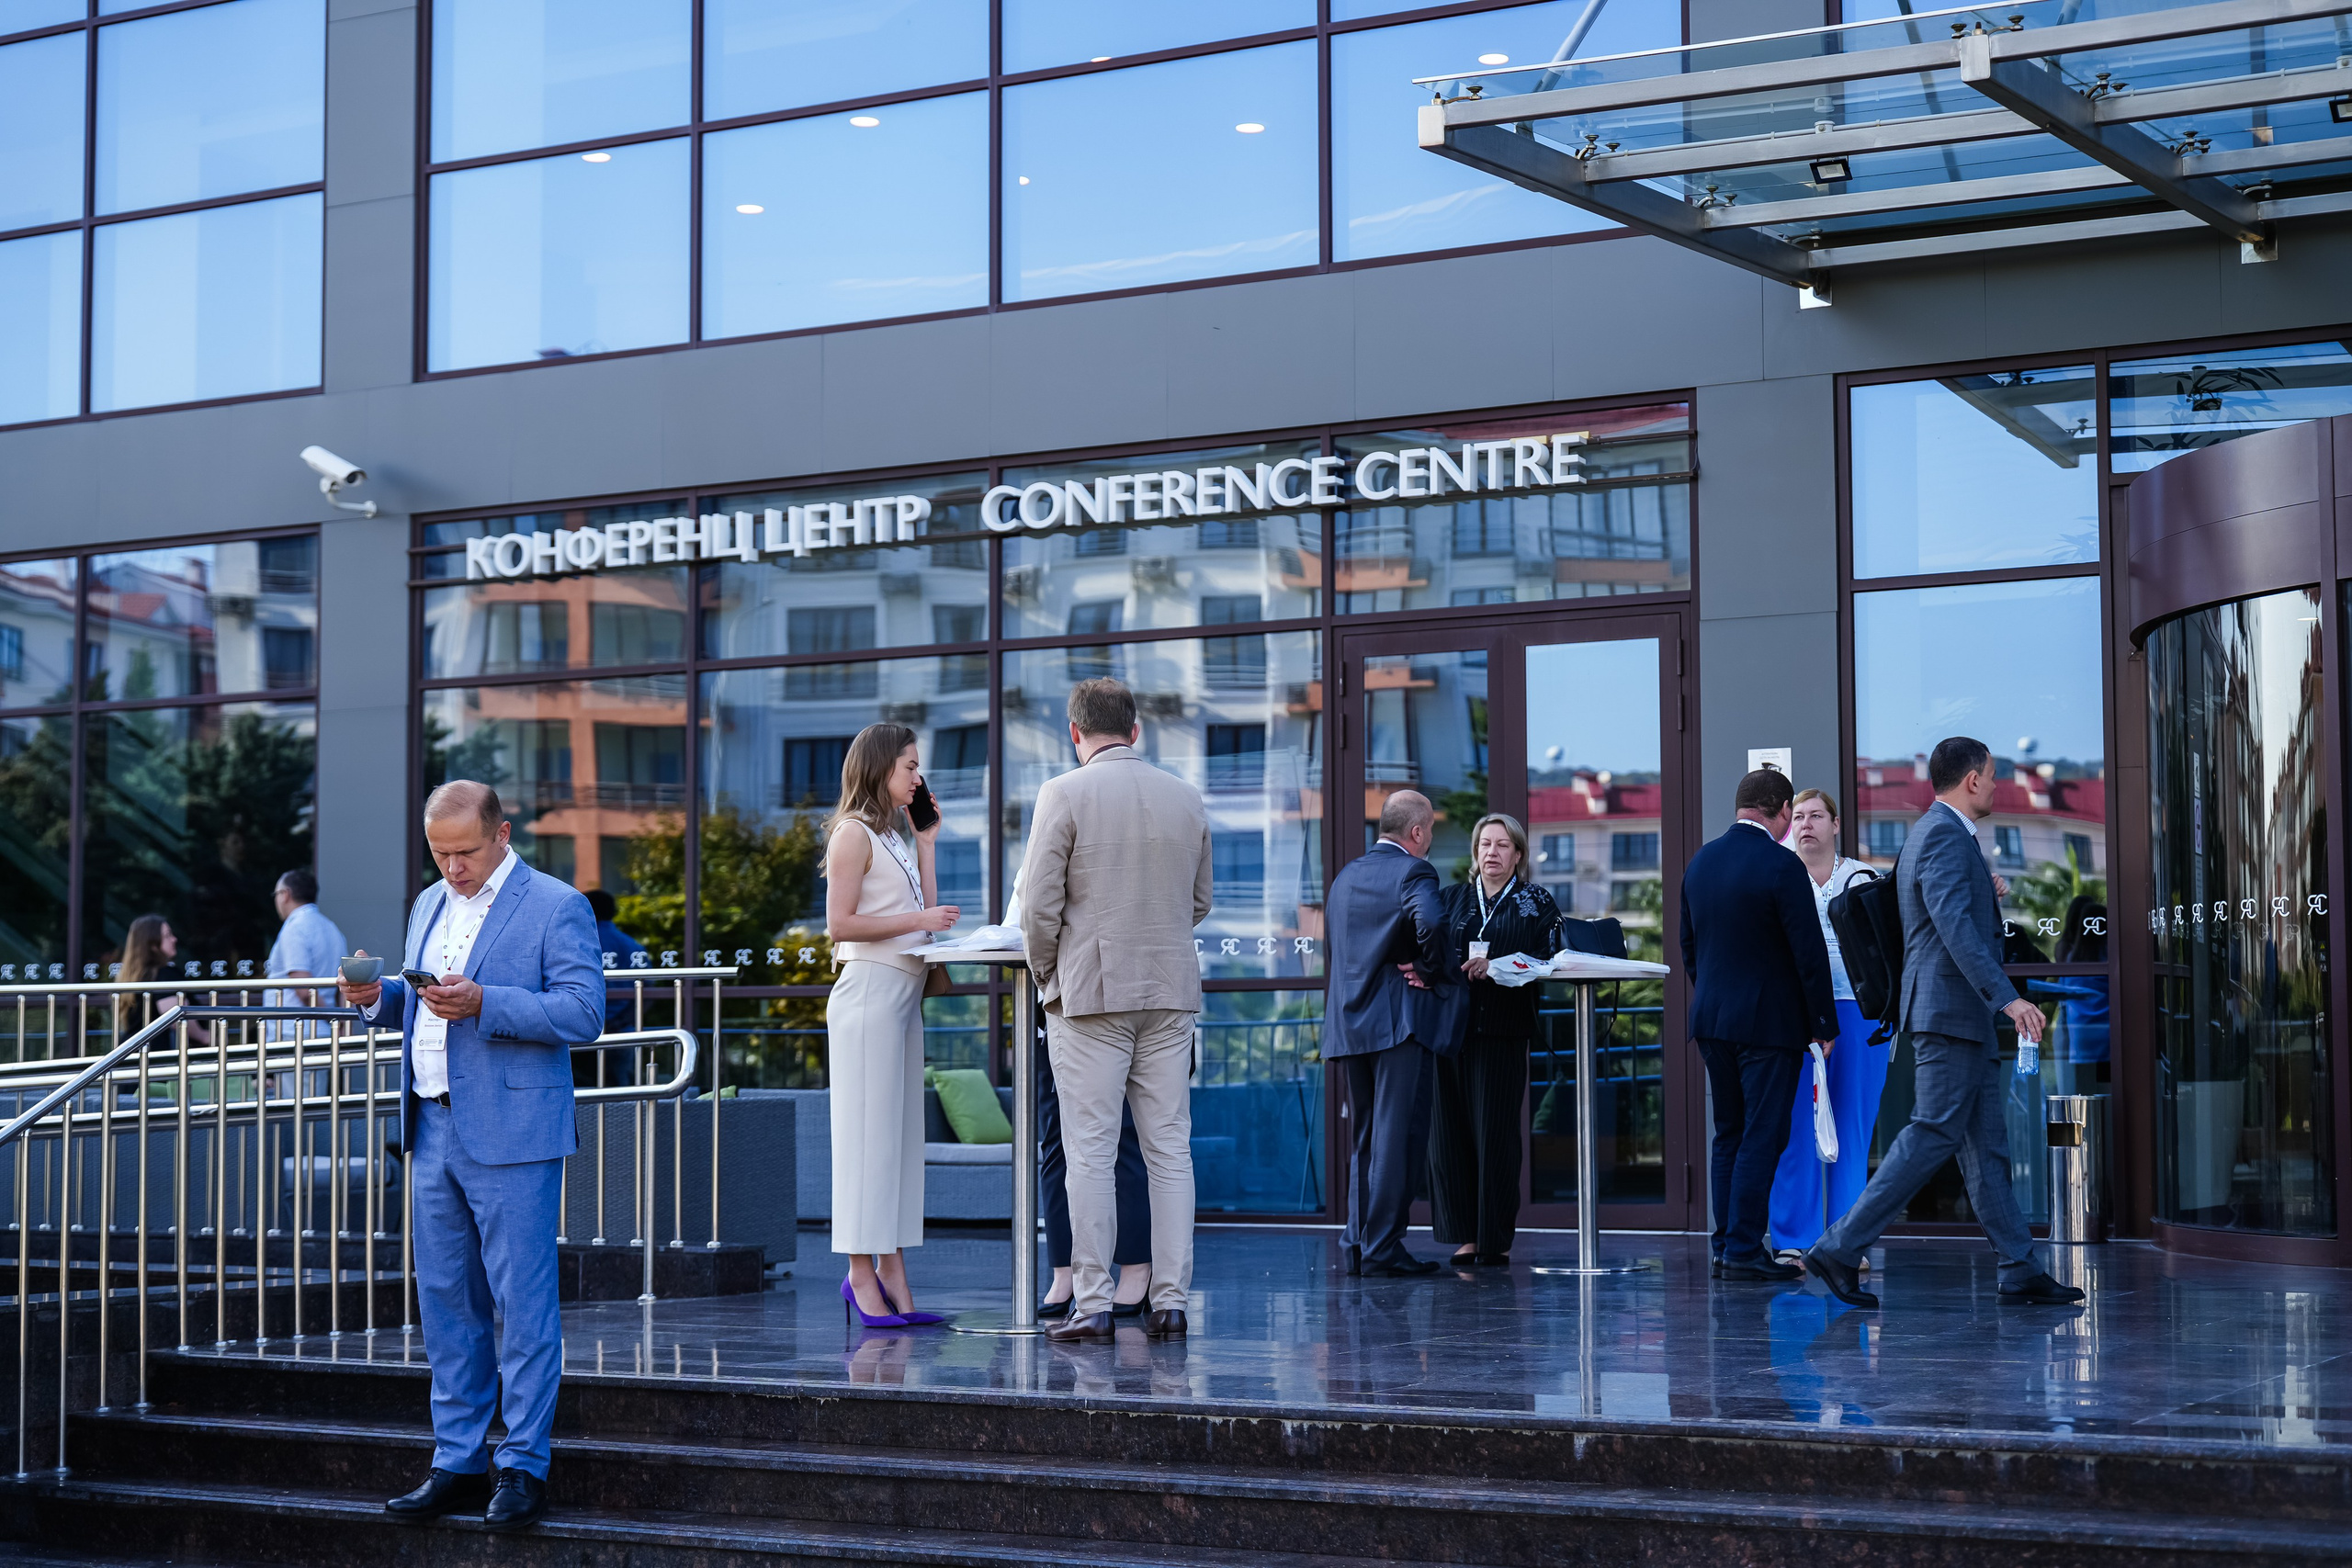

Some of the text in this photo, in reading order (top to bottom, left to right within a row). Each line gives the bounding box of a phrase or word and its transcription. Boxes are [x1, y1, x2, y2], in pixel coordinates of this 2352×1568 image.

[980, 434, 1589, 533] CONFERENCE CENTRE
[465, 494, 932, 581] КОНФЕРЕНЦ ЦЕНТР
